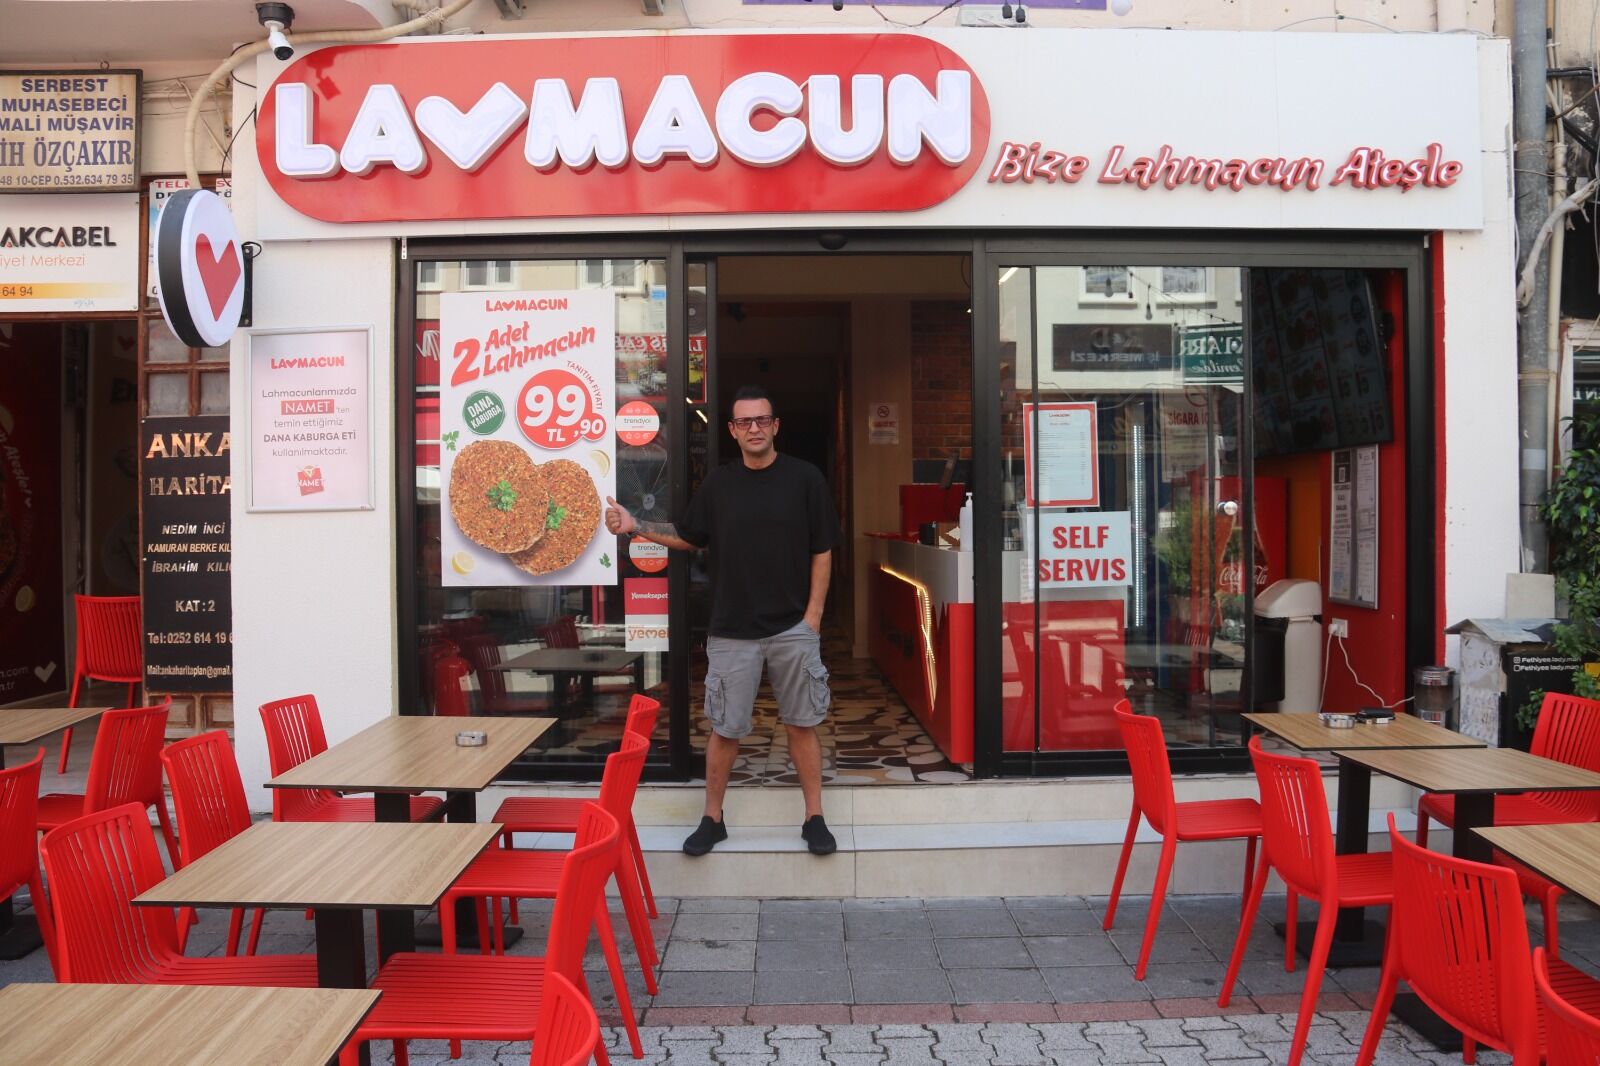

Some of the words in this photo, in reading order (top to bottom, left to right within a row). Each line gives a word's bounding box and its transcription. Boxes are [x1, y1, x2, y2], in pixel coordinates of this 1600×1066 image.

[21, 78, 108, 92] SERBEST
[2, 94, 127, 112] MUHASEBECİ
[0, 115, 41, 131] MALİ
[47, 114, 134, 134] MÜŞAVİR
[33, 137, 133, 172] ÖZÇAKIR
[988, 141, 1089, 183] Bize
[1098, 145, 1324, 191] Lahmacun
[1329, 143, 1463, 193] Ateşle
[54, 175, 102, 185] 0.532.634
[106, 175, 118, 184] 79
[121, 174, 133, 184] 35
[1, 226, 117, 248] AKCABEL
[31, 254, 85, 267] Merkezi
[2, 286, 15, 297] 64
[19, 286, 33, 296] 94
[450, 338, 480, 387] 2
[484, 321, 530, 352] Adet
[483, 326, 596, 377] Lahmacun
[566, 360, 594, 384] TANITIM
[285, 401, 330, 413] NAMET
[467, 395, 494, 418] DANA
[523, 385, 586, 427] 99
[274, 418, 301, 428] temin
[303, 418, 343, 428] ettiğimiz
[470, 404, 502, 430] KABURGA
[264, 434, 291, 443] DANA
[293, 432, 339, 442] KABURGA
[342, 430, 356, 440] ETİ
[546, 428, 566, 442] TL
[272, 447, 348, 457] kullanılmaktadır.
[162, 524, 197, 535] NEDİM
[203, 522, 225, 534] İNCİ
[1052, 525, 1110, 549] SELF
[147, 543, 188, 553] KAMURAN
[190, 543, 217, 553] BERKE
[152, 561, 198, 573] İBRAHİM
[1039, 558, 1126, 582] SERVIS
[194, 632, 211, 644] 614
[215, 632, 227, 644] 19
